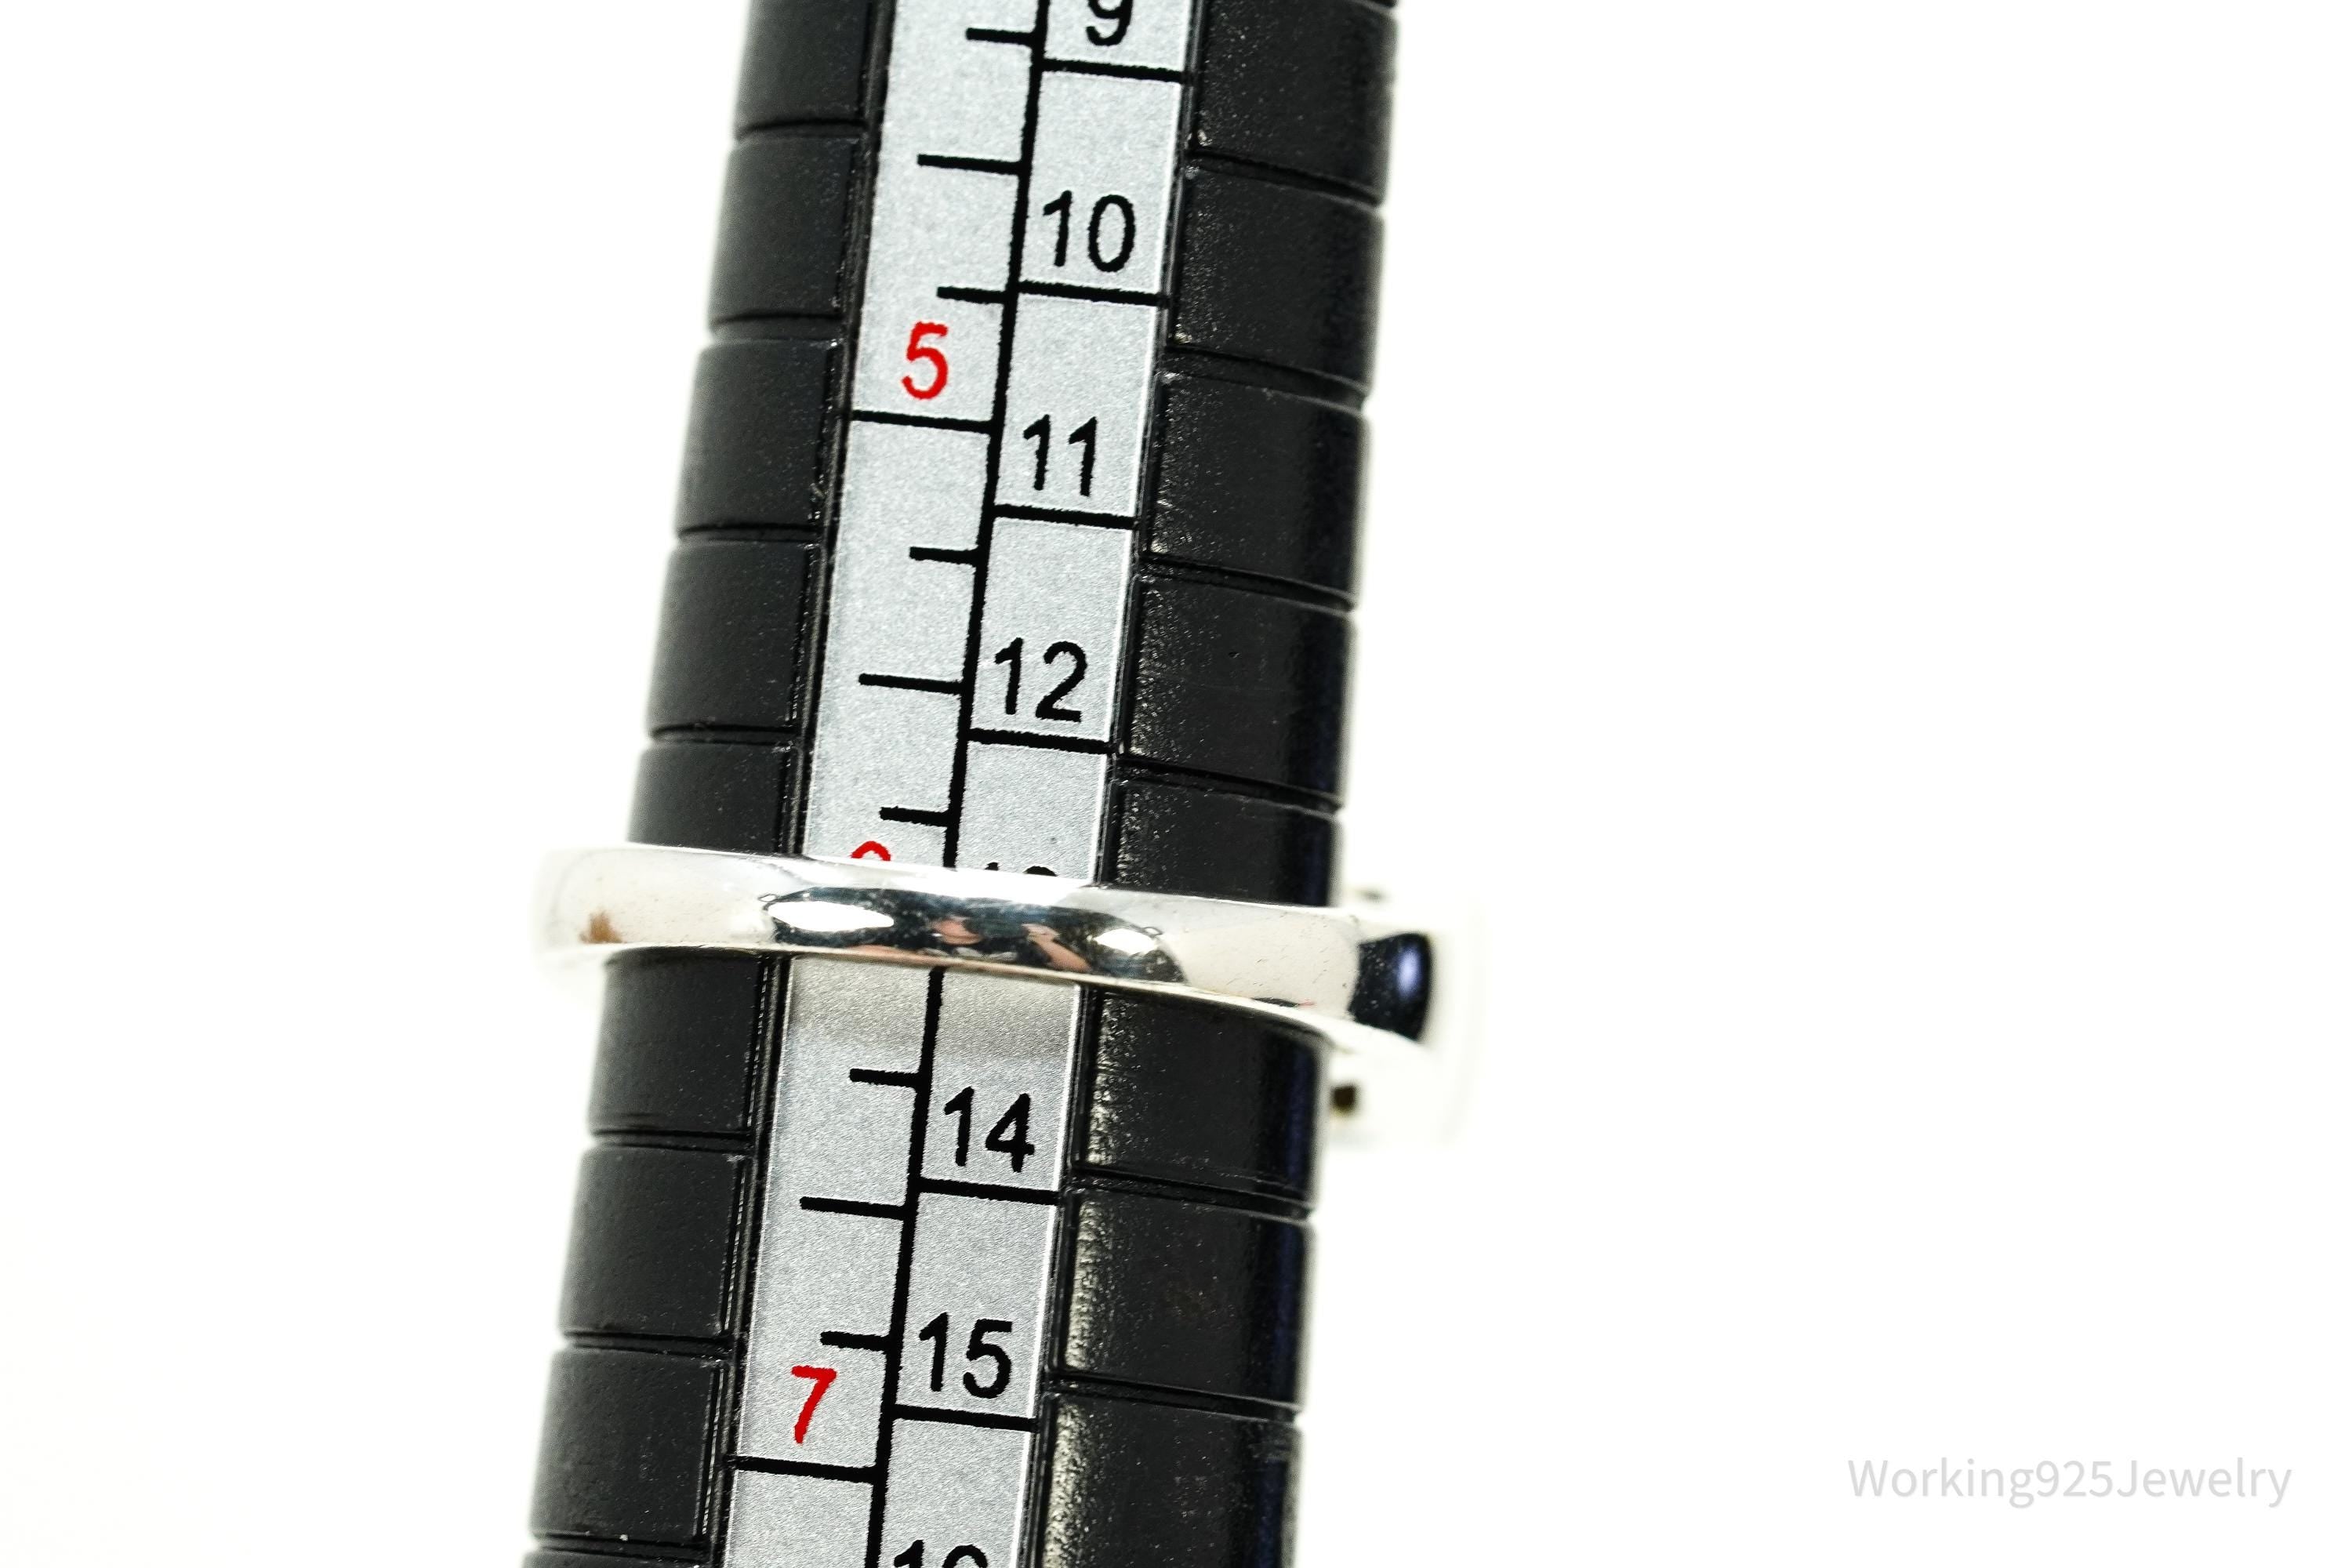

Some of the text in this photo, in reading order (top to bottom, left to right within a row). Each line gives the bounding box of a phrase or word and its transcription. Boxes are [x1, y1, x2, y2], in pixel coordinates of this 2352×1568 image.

[1044, 191, 1135, 272] 10
[902, 322, 947, 399] 5
[1024, 415, 1097, 496] 11
[995, 637, 1087, 723] 12
[944, 1087, 1035, 1173] 14
[919, 1312, 1012, 1399] 15
[792, 1366, 837, 1443] 7
